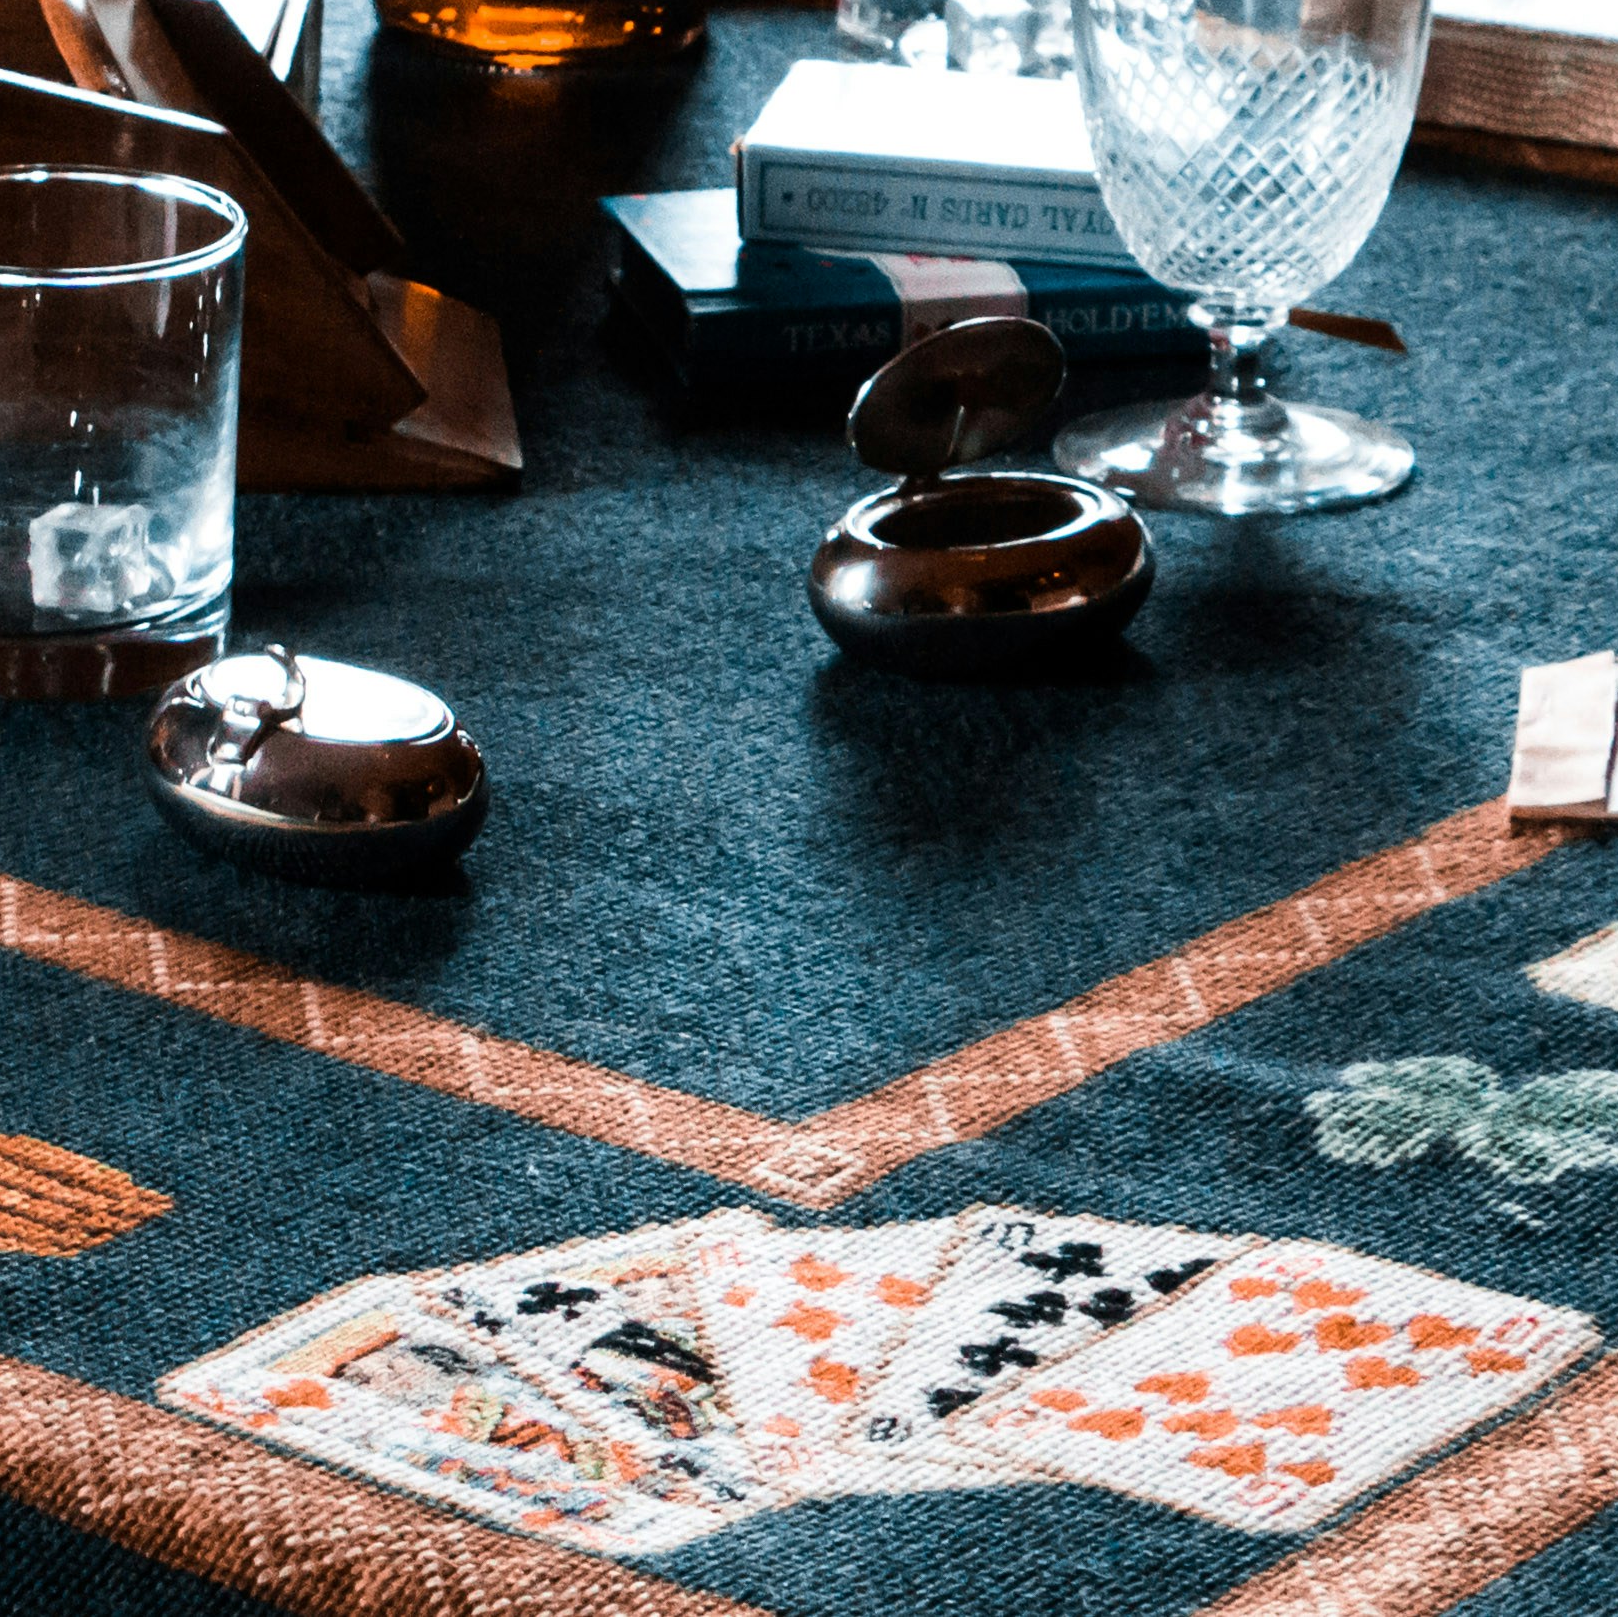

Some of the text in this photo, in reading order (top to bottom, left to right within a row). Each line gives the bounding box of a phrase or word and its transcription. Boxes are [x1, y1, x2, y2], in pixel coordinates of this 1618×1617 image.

[941, 196, 1029, 229] CARDS
[1041, 202, 1117, 234] OYAL
[783, 321, 892, 354] TEXAS
